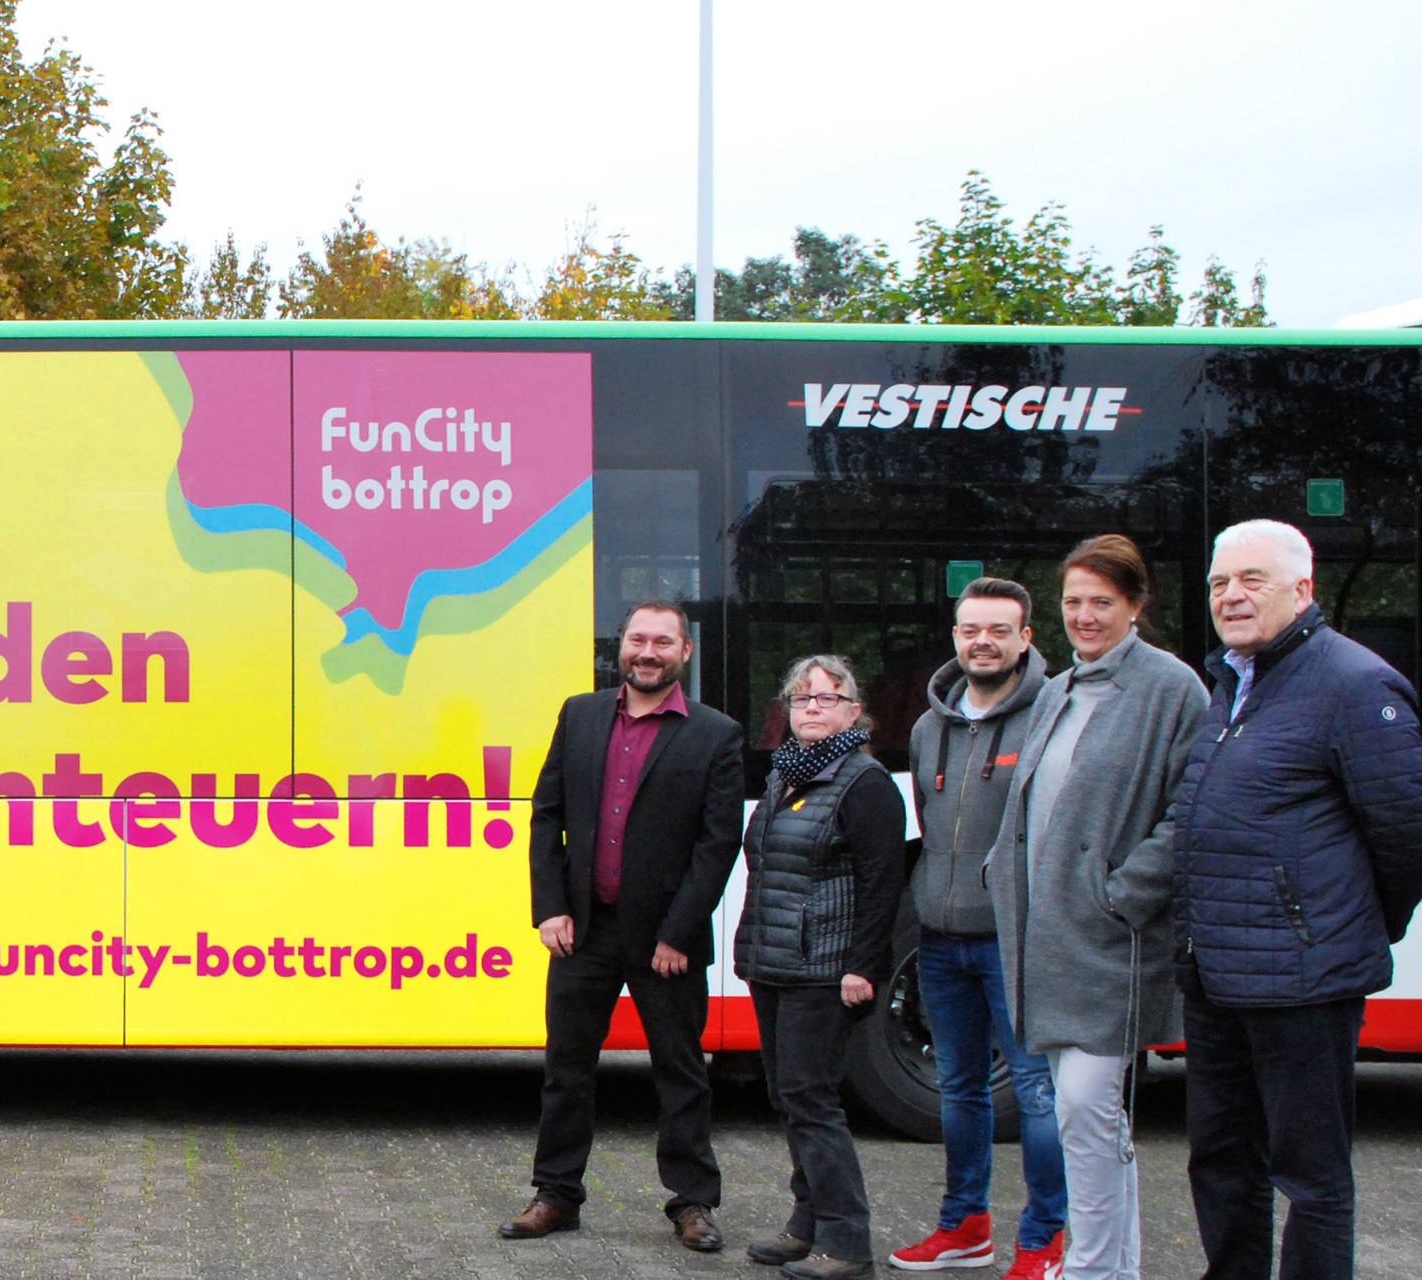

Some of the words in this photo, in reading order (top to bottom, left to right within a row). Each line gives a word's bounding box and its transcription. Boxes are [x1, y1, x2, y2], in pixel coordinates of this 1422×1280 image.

[321, 407, 512, 467] FunCity
[804, 383, 1127, 431] VESTISCHE
[321, 464, 513, 524] bottrop
